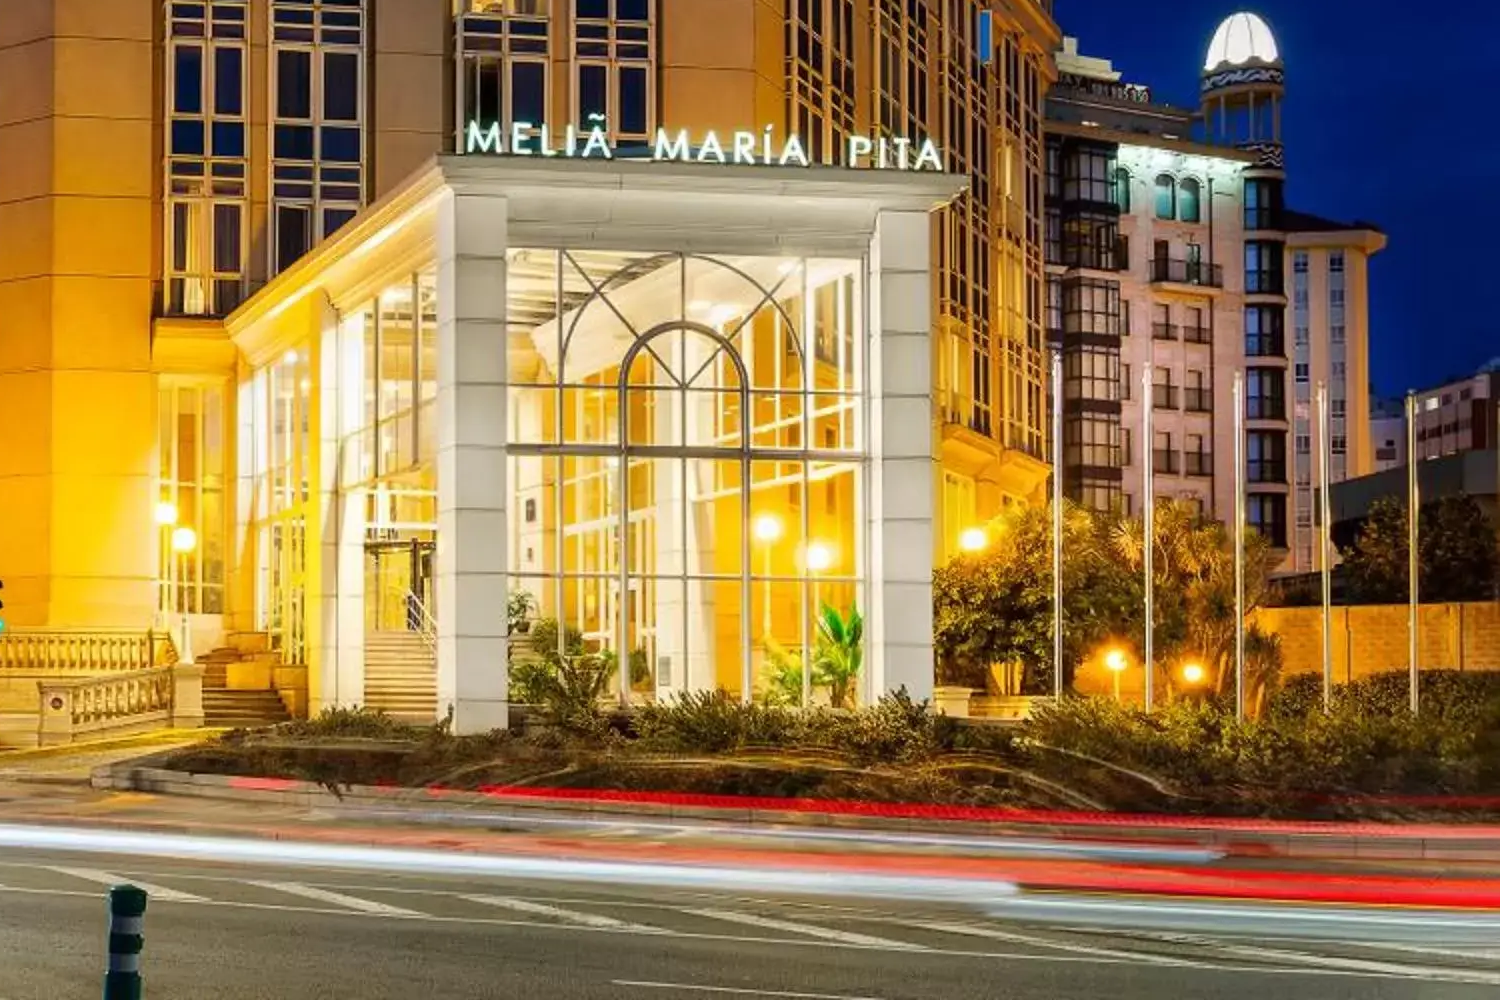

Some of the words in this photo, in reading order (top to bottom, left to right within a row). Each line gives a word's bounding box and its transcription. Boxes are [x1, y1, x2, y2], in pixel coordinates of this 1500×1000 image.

[467, 113, 612, 158] MELIÃ
[654, 123, 809, 166] MARÍA
[849, 135, 942, 170] PITA
